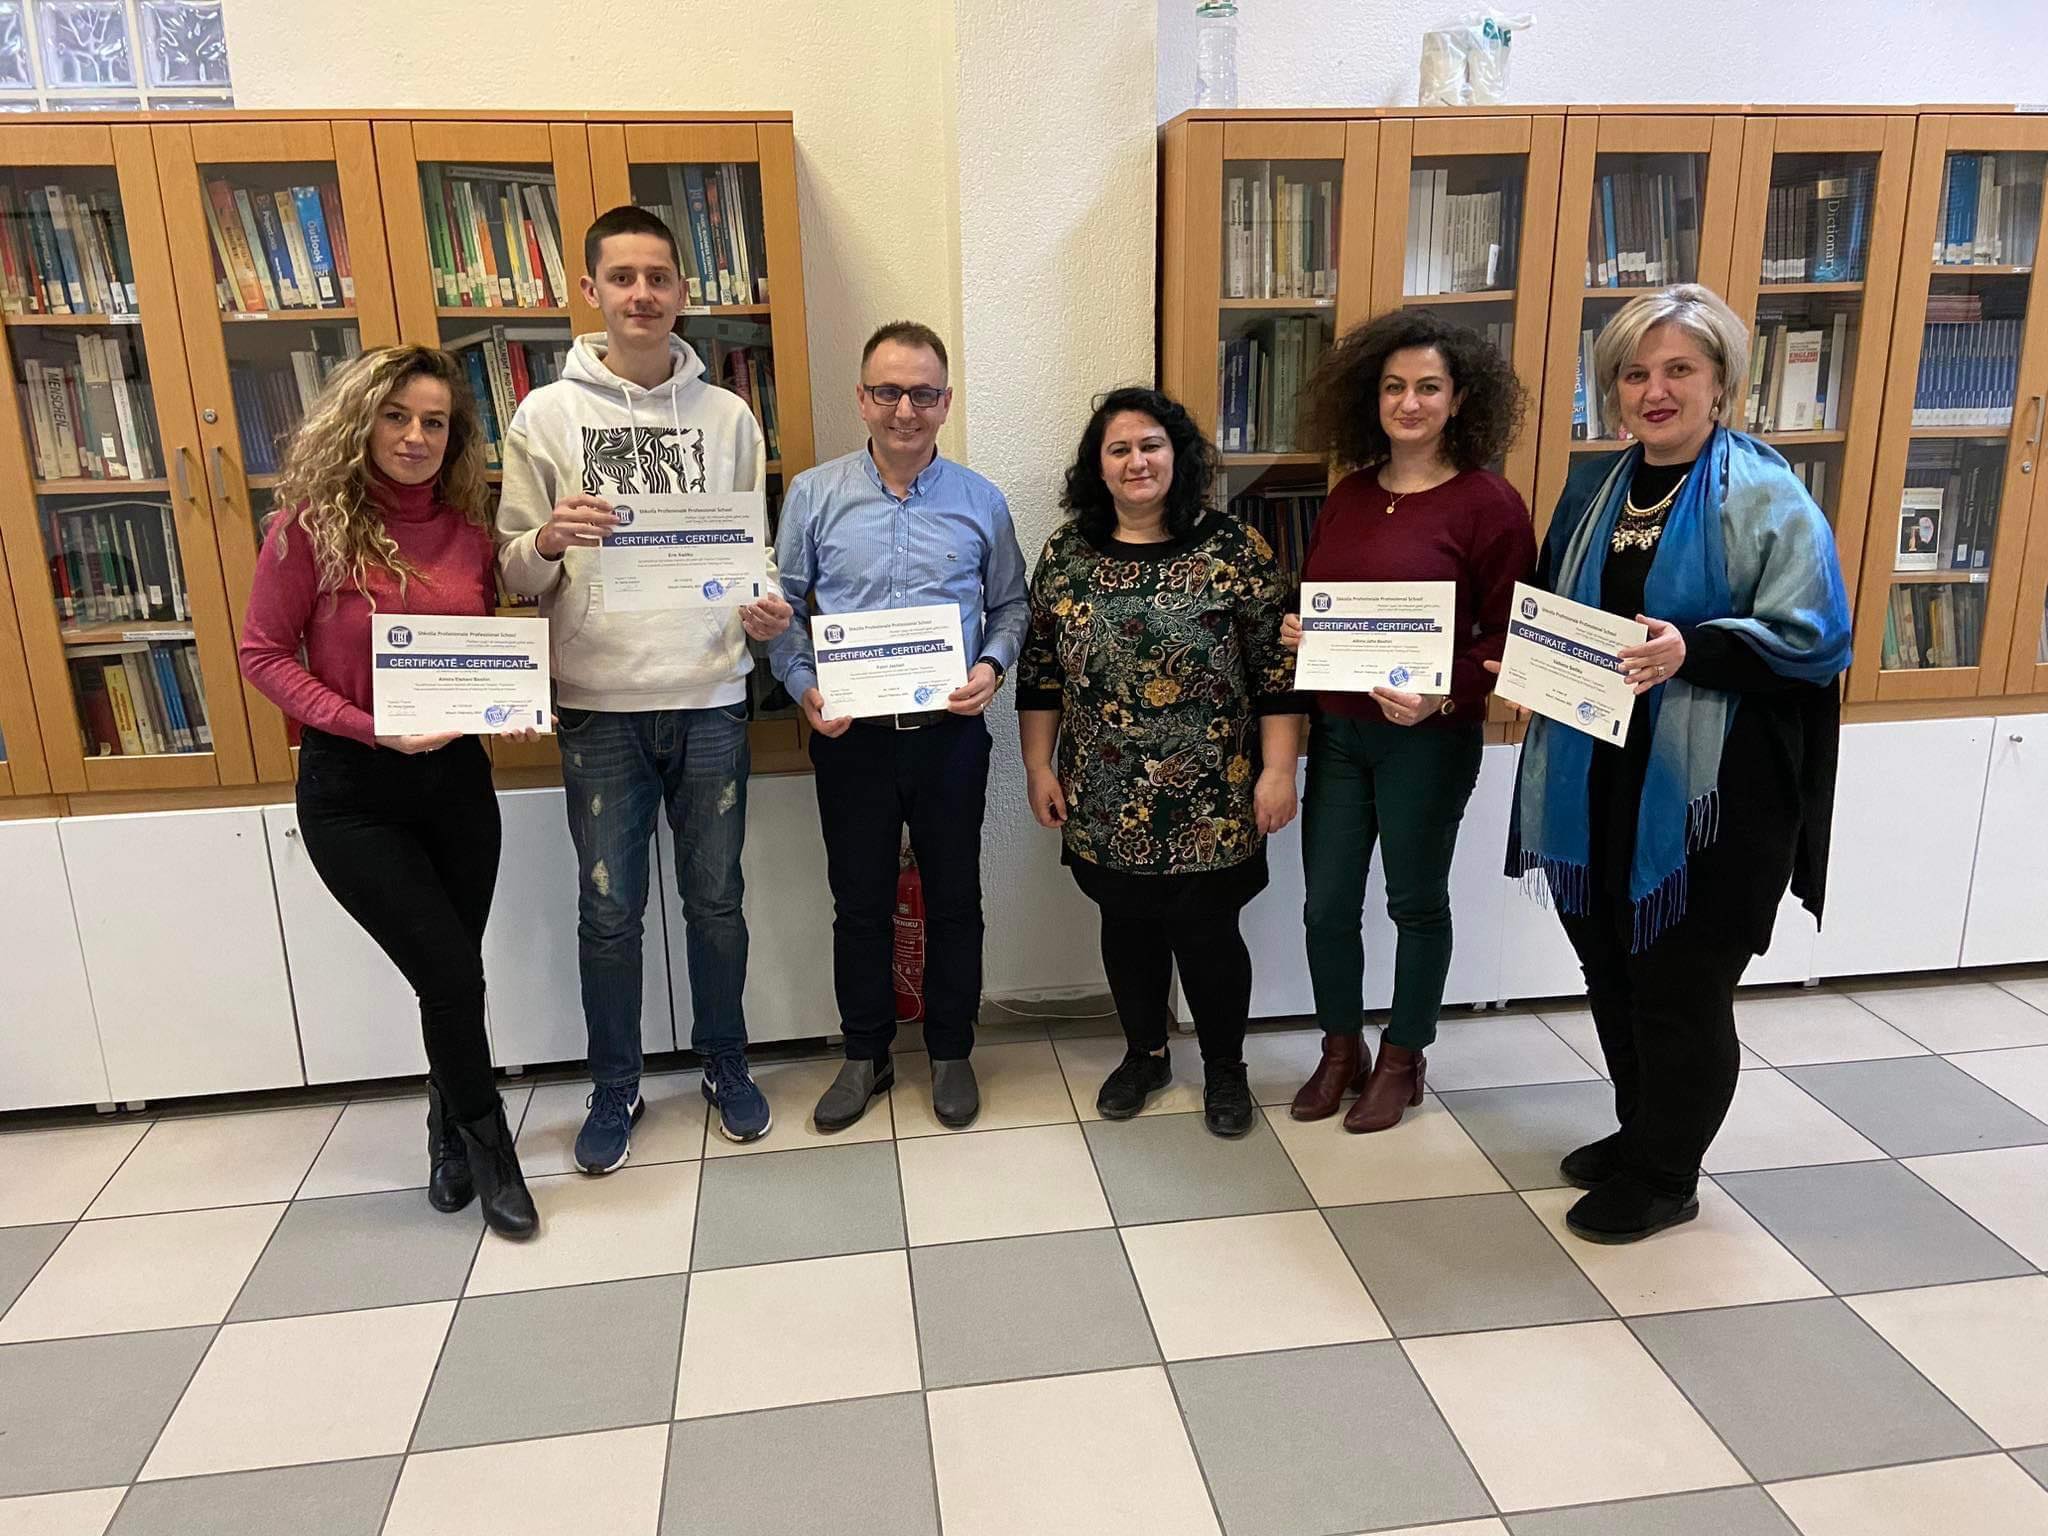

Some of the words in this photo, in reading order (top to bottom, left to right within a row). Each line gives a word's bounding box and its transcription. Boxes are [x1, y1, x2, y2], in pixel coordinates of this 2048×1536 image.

[1823, 199, 1840, 270] Dictionary
[307, 220, 325, 263] Outlook
[685, 533, 747, 544] CERTIFICATE
[1376, 622, 1436, 632] CERTIFICATE
[891, 642, 948, 655] CERTIFICATE
[466, 659, 531, 669] CERTIFICATE
[1572, 646, 1620, 671] CERTIFICAT
